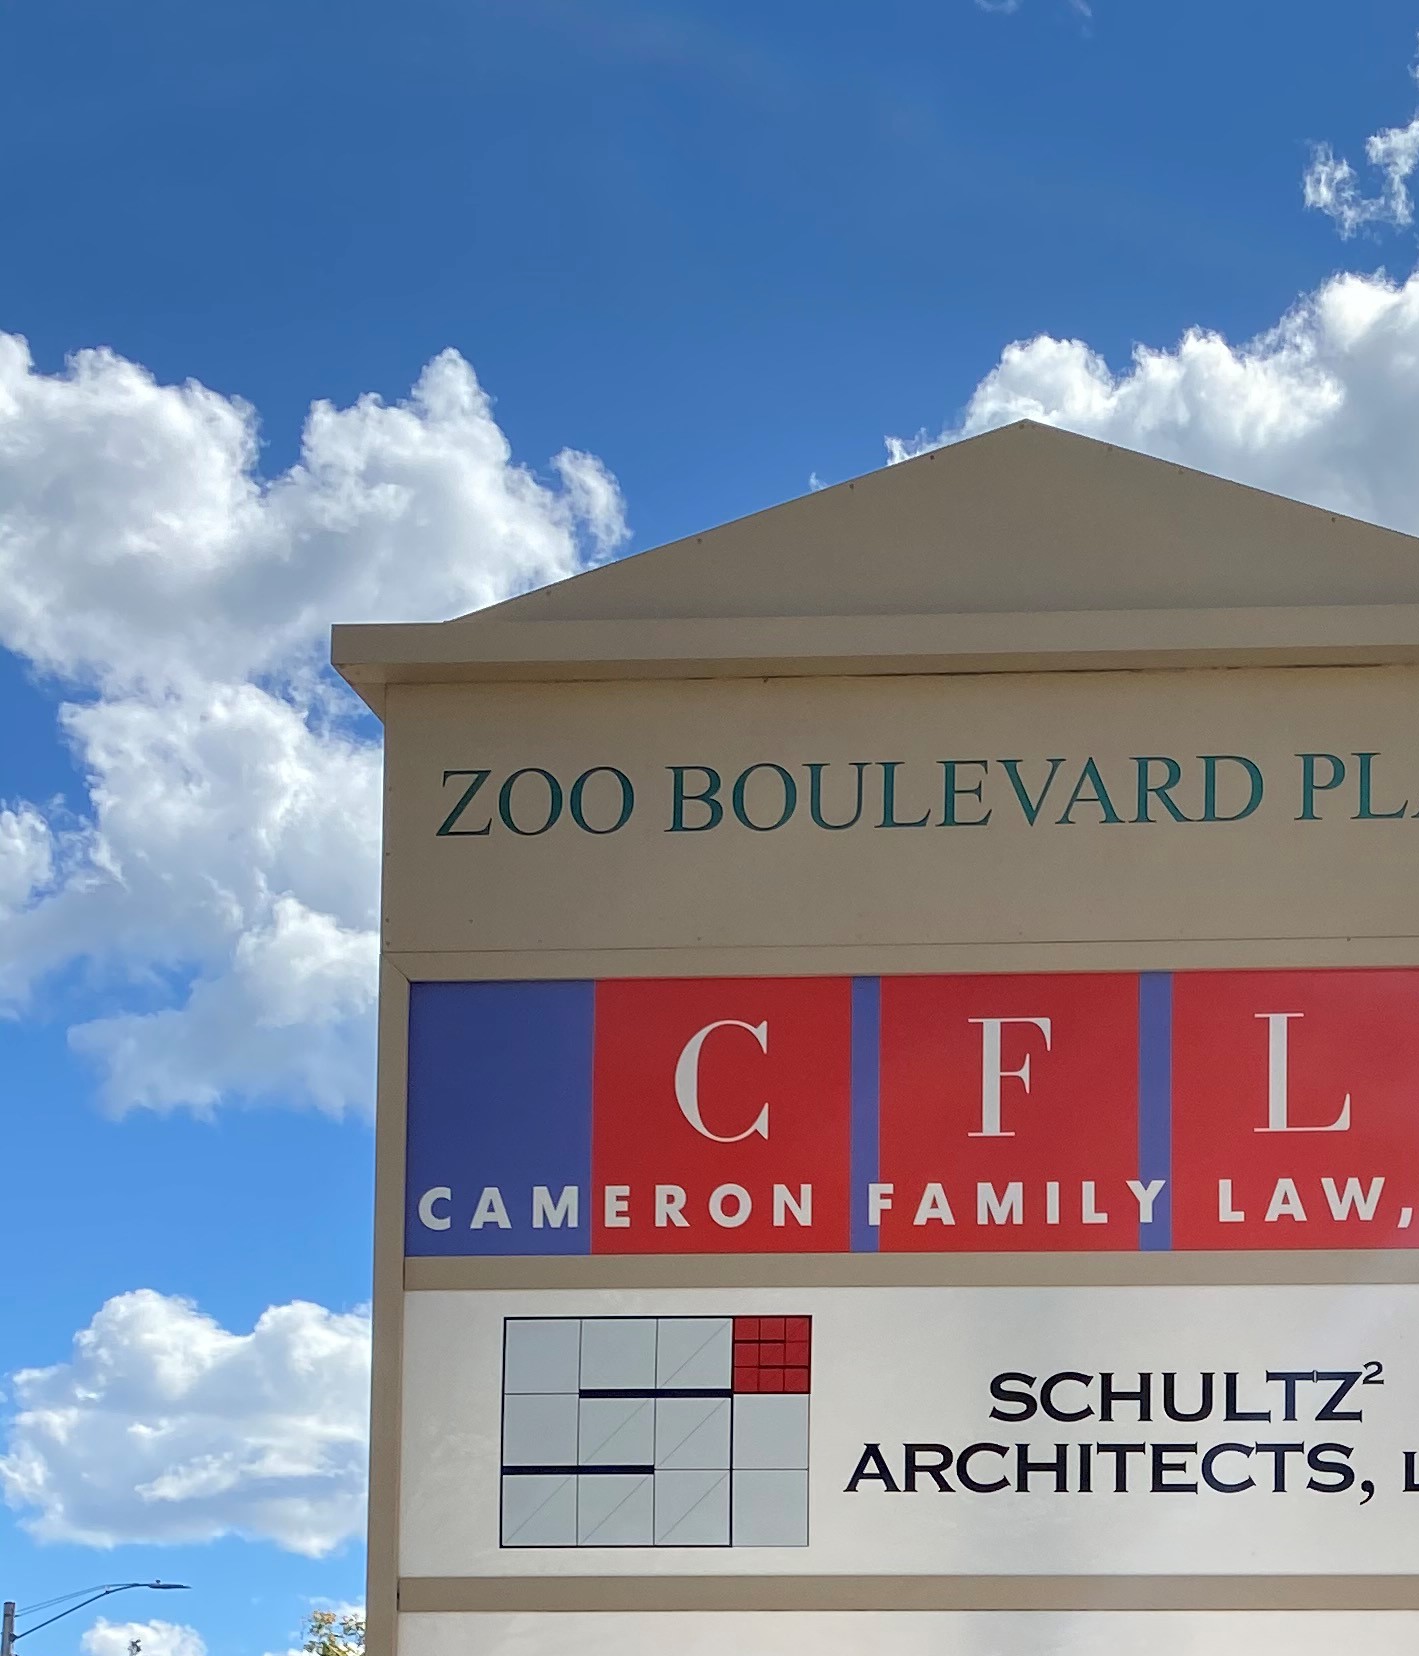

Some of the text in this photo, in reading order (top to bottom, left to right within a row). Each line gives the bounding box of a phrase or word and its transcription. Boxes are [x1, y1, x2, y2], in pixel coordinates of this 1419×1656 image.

[435, 765, 636, 838] ZOO
[666, 754, 1264, 834] BOULEVARD
[675, 1013, 1350, 1143] C F L
[419, 1183, 814, 1230] CAMERON
[869, 1178, 1167, 1226] FAMILY
[1216, 1176, 1413, 1229] LAW,
[844, 1441, 1375, 1506] ARCHITECTS,
